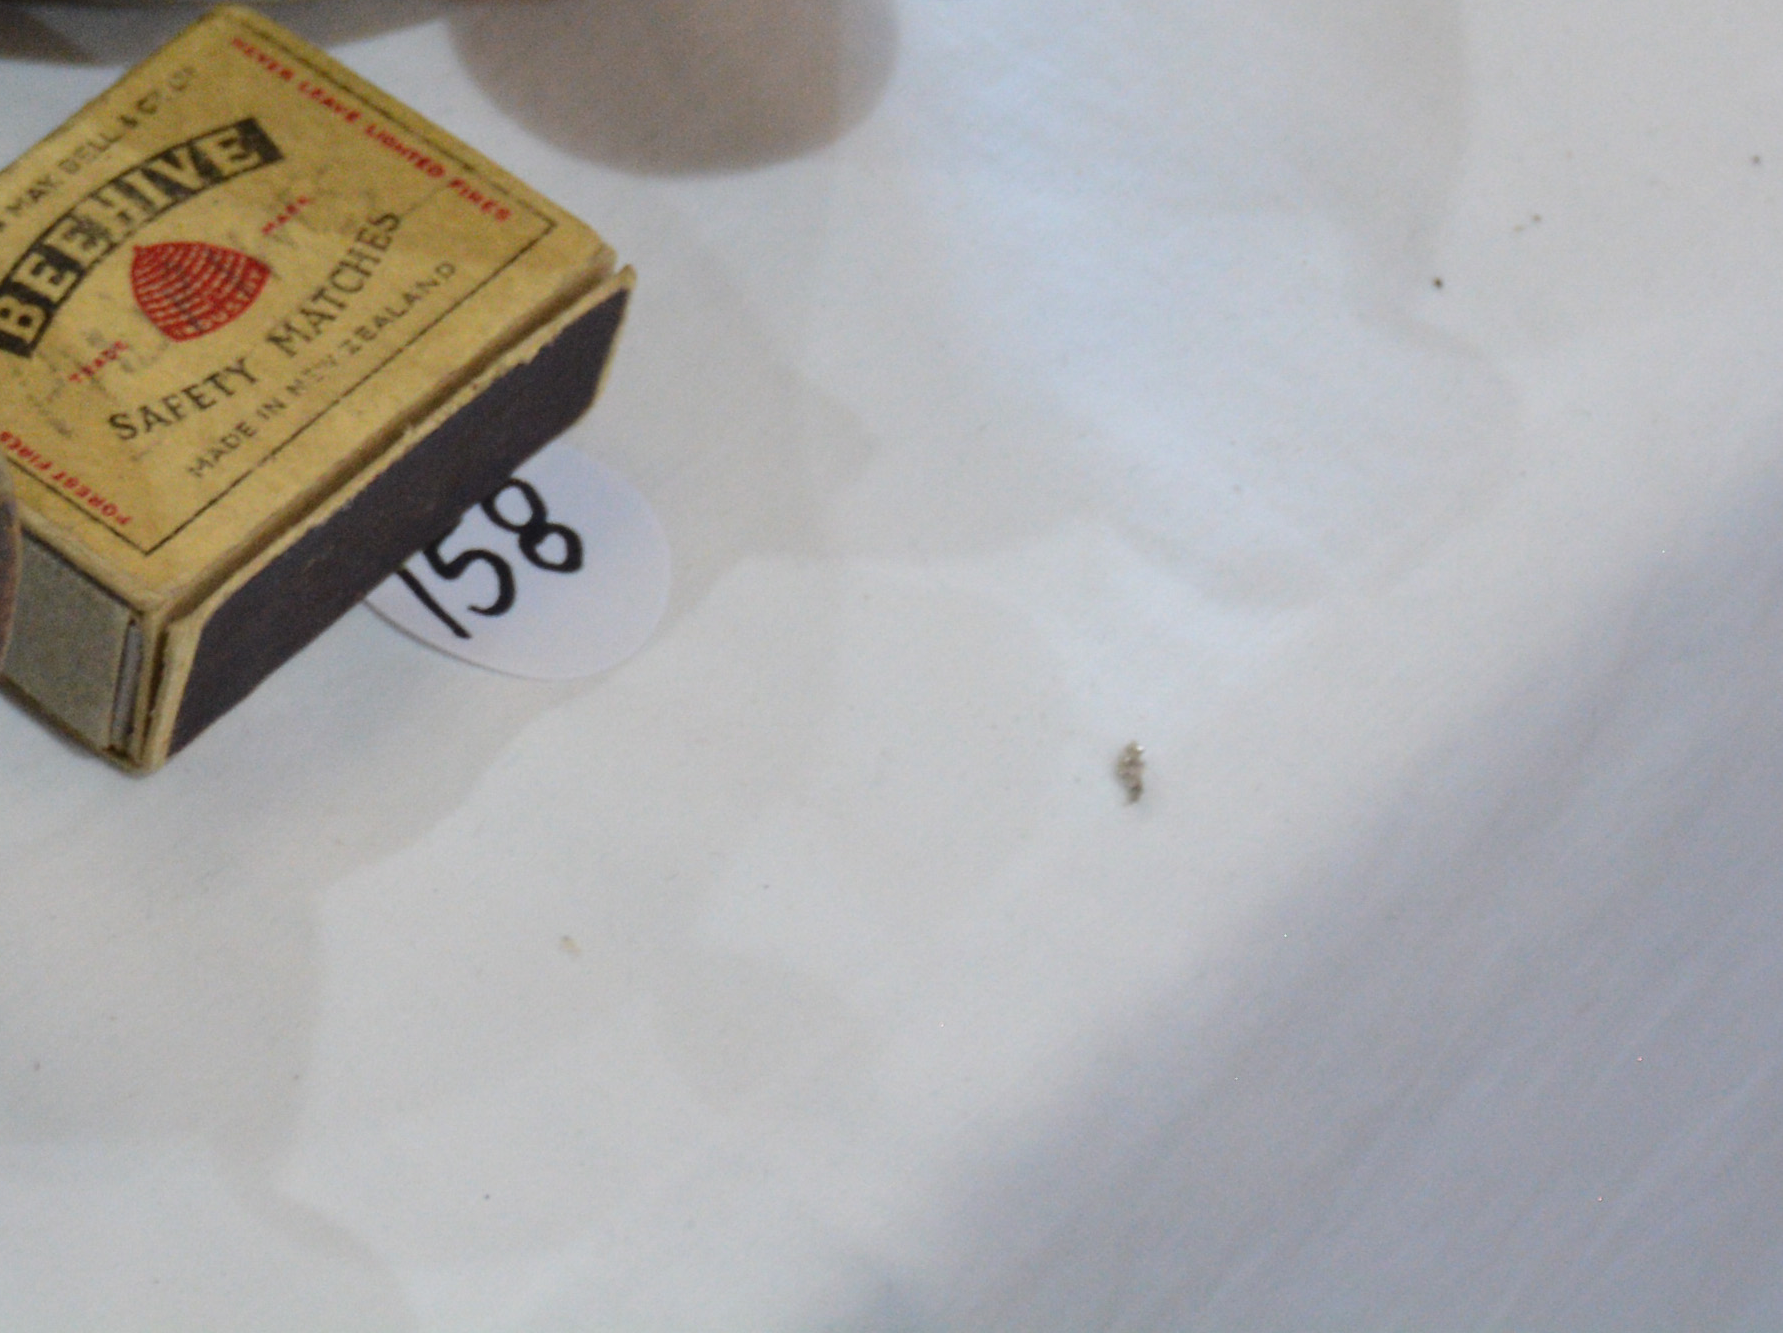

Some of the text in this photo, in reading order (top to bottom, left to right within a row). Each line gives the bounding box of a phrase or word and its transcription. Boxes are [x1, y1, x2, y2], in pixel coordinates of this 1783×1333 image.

[298, 81, 362, 124] LEAVE
[364, 123, 447, 180] LIGHTED
[447, 177, 512, 223] FIRES
[107, 210, 401, 441] SAFETY MATCHES
[188, 420, 258, 479] MADE
[256, 396, 288, 422] IN
[338, 260, 458, 356] ZEALAND
[51, 470, 132, 526] FOREST
[392, 477, 585, 640] 158
